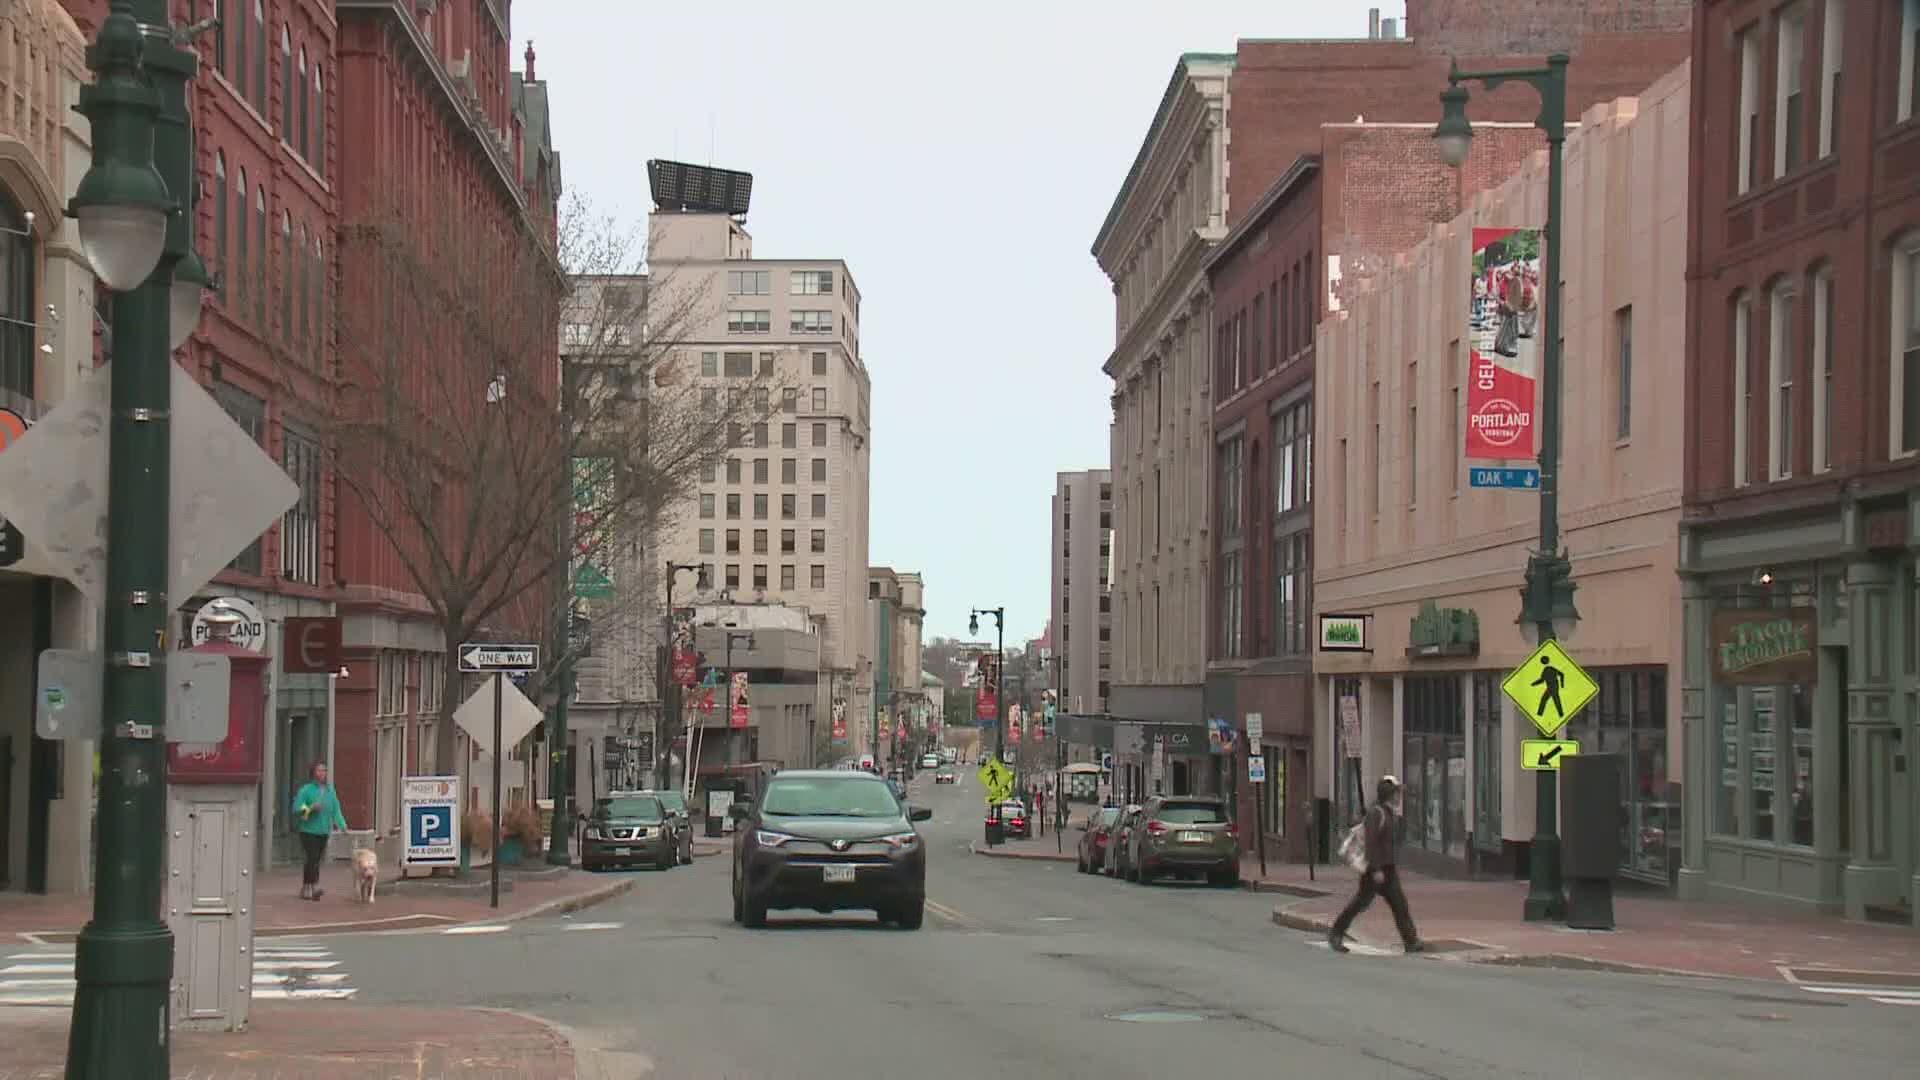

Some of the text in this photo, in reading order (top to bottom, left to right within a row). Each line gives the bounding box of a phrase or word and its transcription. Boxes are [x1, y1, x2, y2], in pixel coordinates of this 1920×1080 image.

[1478, 298, 1497, 390] CELEBRATE
[1471, 412, 1530, 428] PORTLAND
[1478, 471, 1501, 485] OAK
[1730, 618, 1792, 646] TACO
[479, 653, 530, 663] ONE WAY
[1154, 732, 1189, 743] MCA
[421, 814, 440, 838] P
